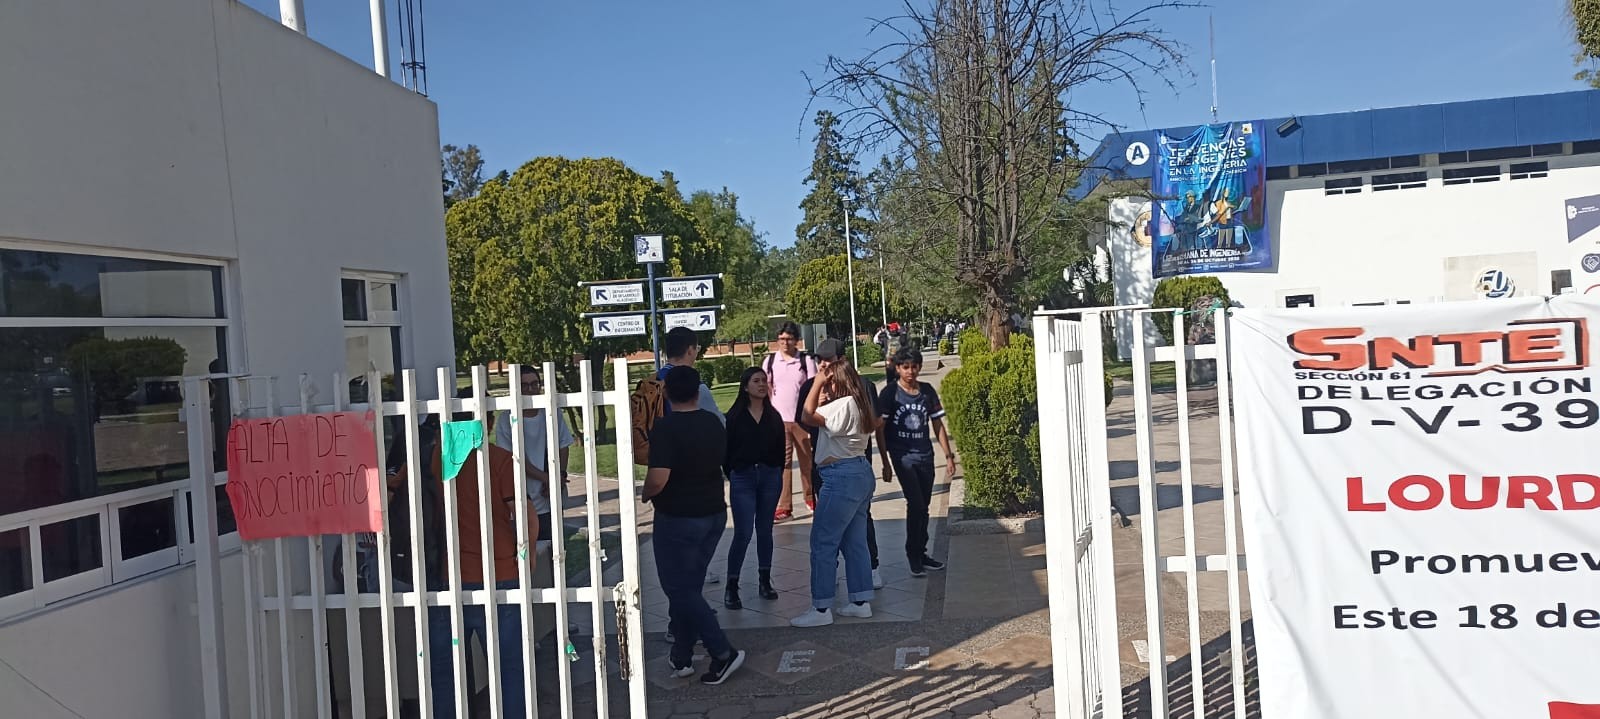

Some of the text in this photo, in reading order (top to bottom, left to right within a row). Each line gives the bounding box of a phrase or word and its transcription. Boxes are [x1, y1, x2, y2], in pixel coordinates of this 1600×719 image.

[1132, 145, 1144, 160] A
[1171, 137, 1246, 157] TENENCAS
[1169, 168, 1181, 176] EN
[1184, 167, 1195, 175] LA
[1199, 159, 1247, 174] INGEIERIA
[1286, 327, 1566, 371] SNTE
[1295, 371, 1412, 381] SECCIÓN 61
[1297, 377, 1592, 401] DELEGACIÓN
[315, 414, 347, 458] DE
[898, 431, 910, 439] EST
[1346, 474, 1600, 512] LOURD
[1370, 550, 1600, 574] Promuev
[1333, 602, 1600, 630] Este 18 de
